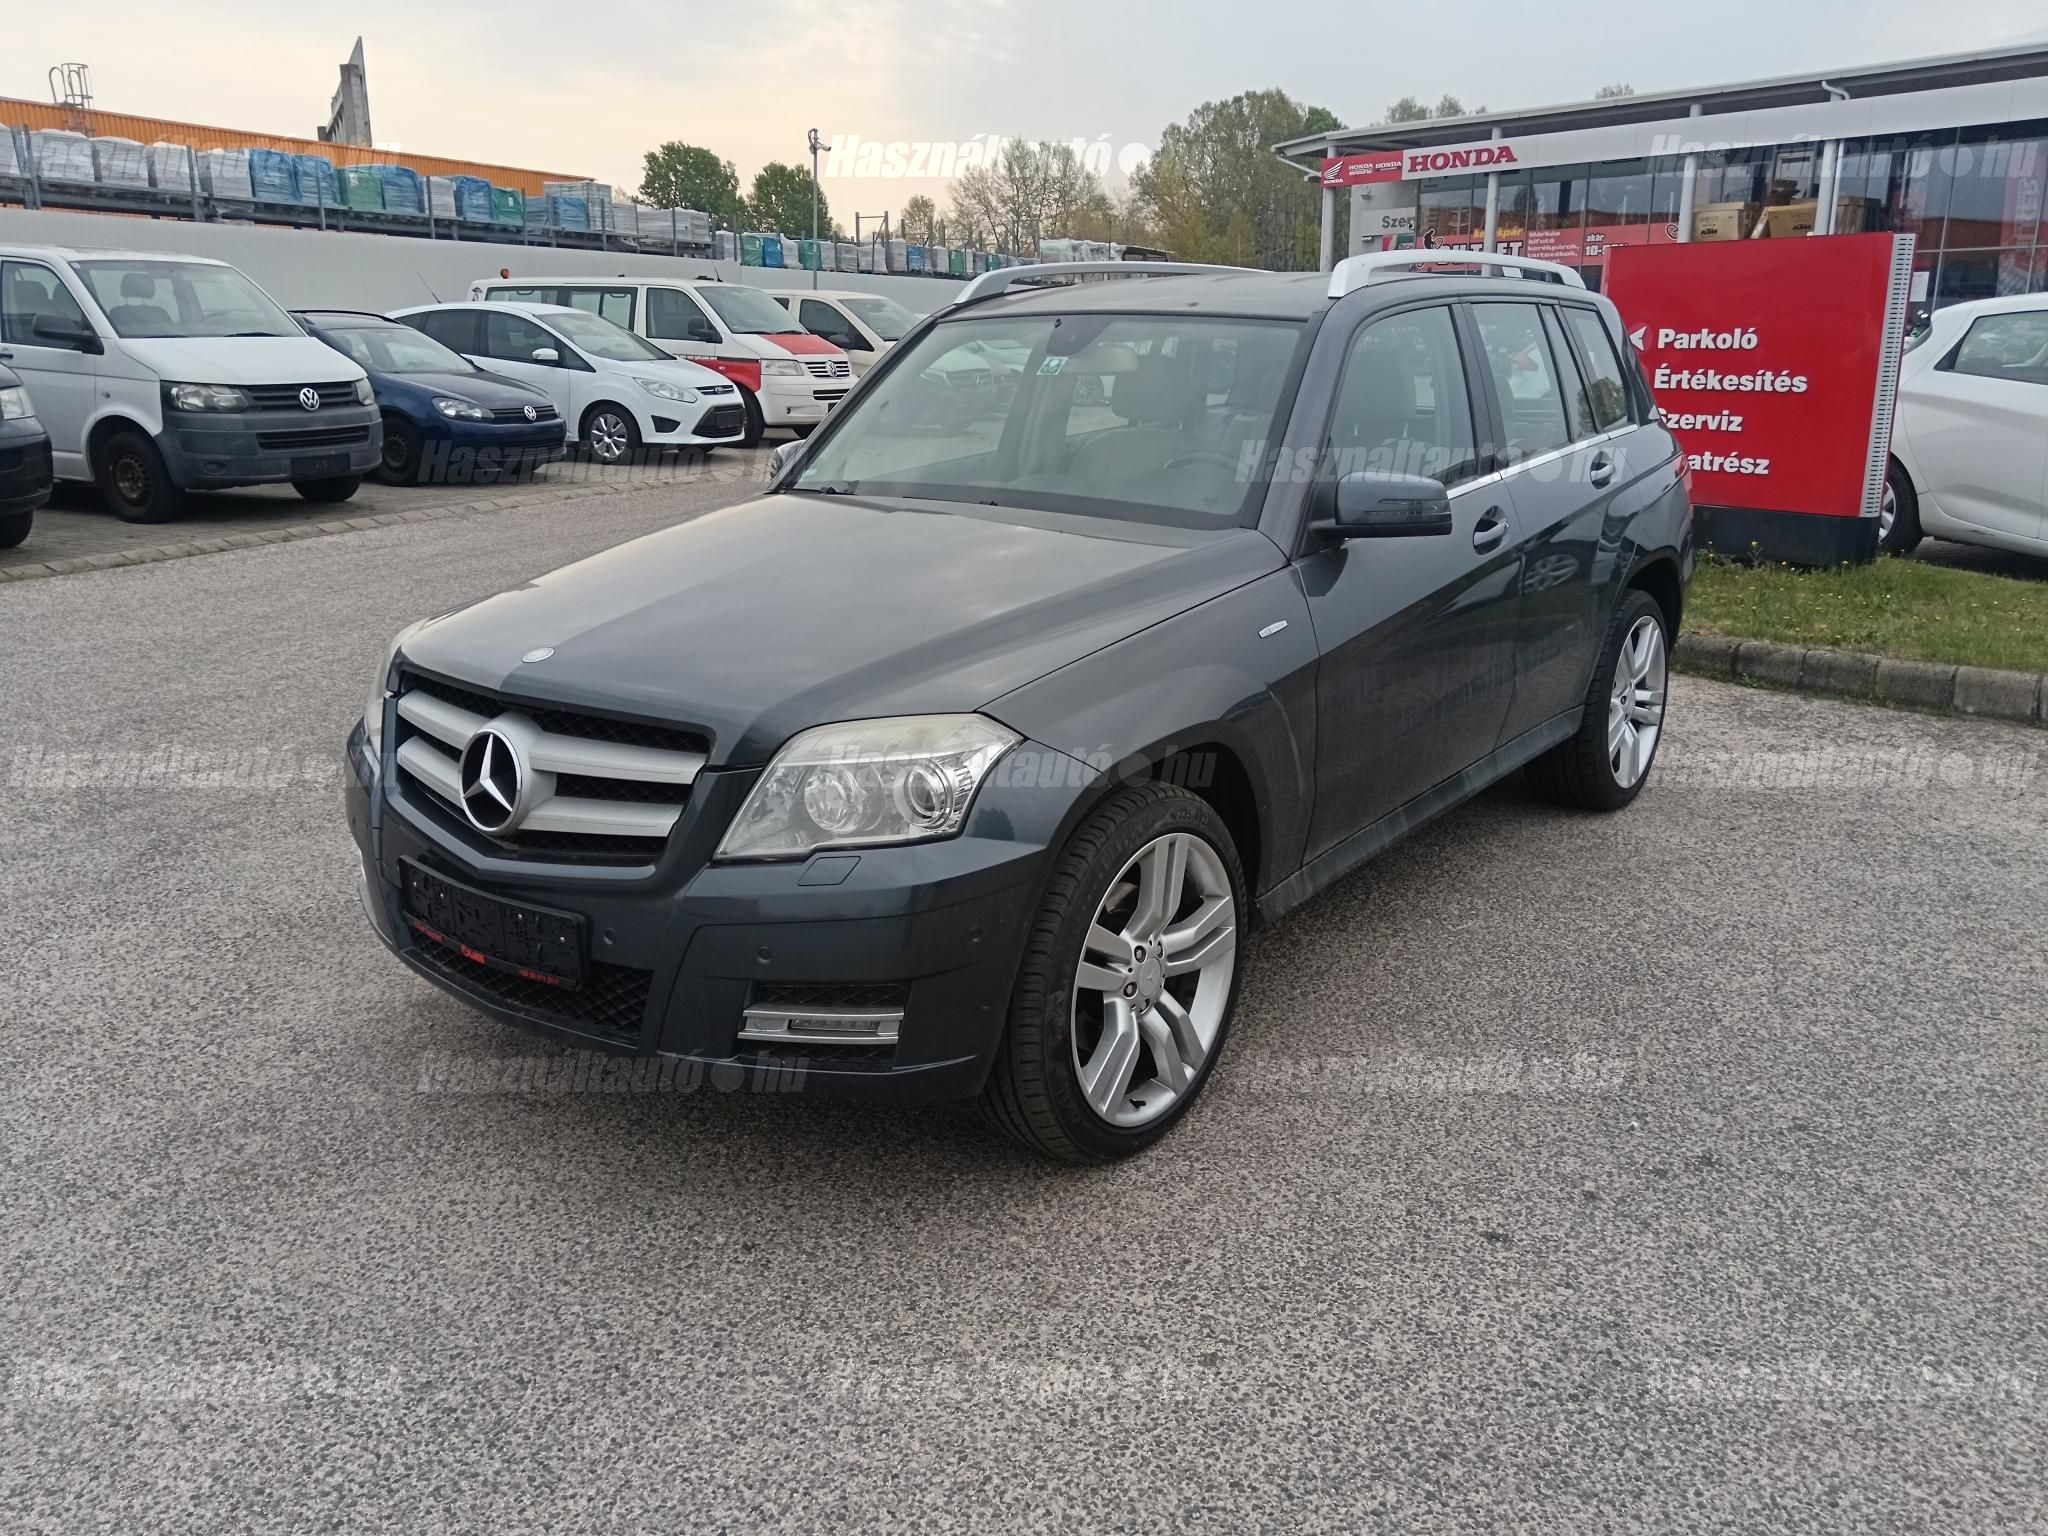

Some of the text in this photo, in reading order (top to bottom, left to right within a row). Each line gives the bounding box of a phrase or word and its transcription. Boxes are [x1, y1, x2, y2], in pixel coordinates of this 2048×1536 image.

[1375, 161, 1402, 169] HONDA
[1408, 145, 1517, 173] HONDA
[1473, 225, 1524, 239] kekpár
[1657, 327, 1759, 350] Parkoló
[1653, 363, 1809, 393] Értékesítés
[1687, 451, 1770, 475] atrész
